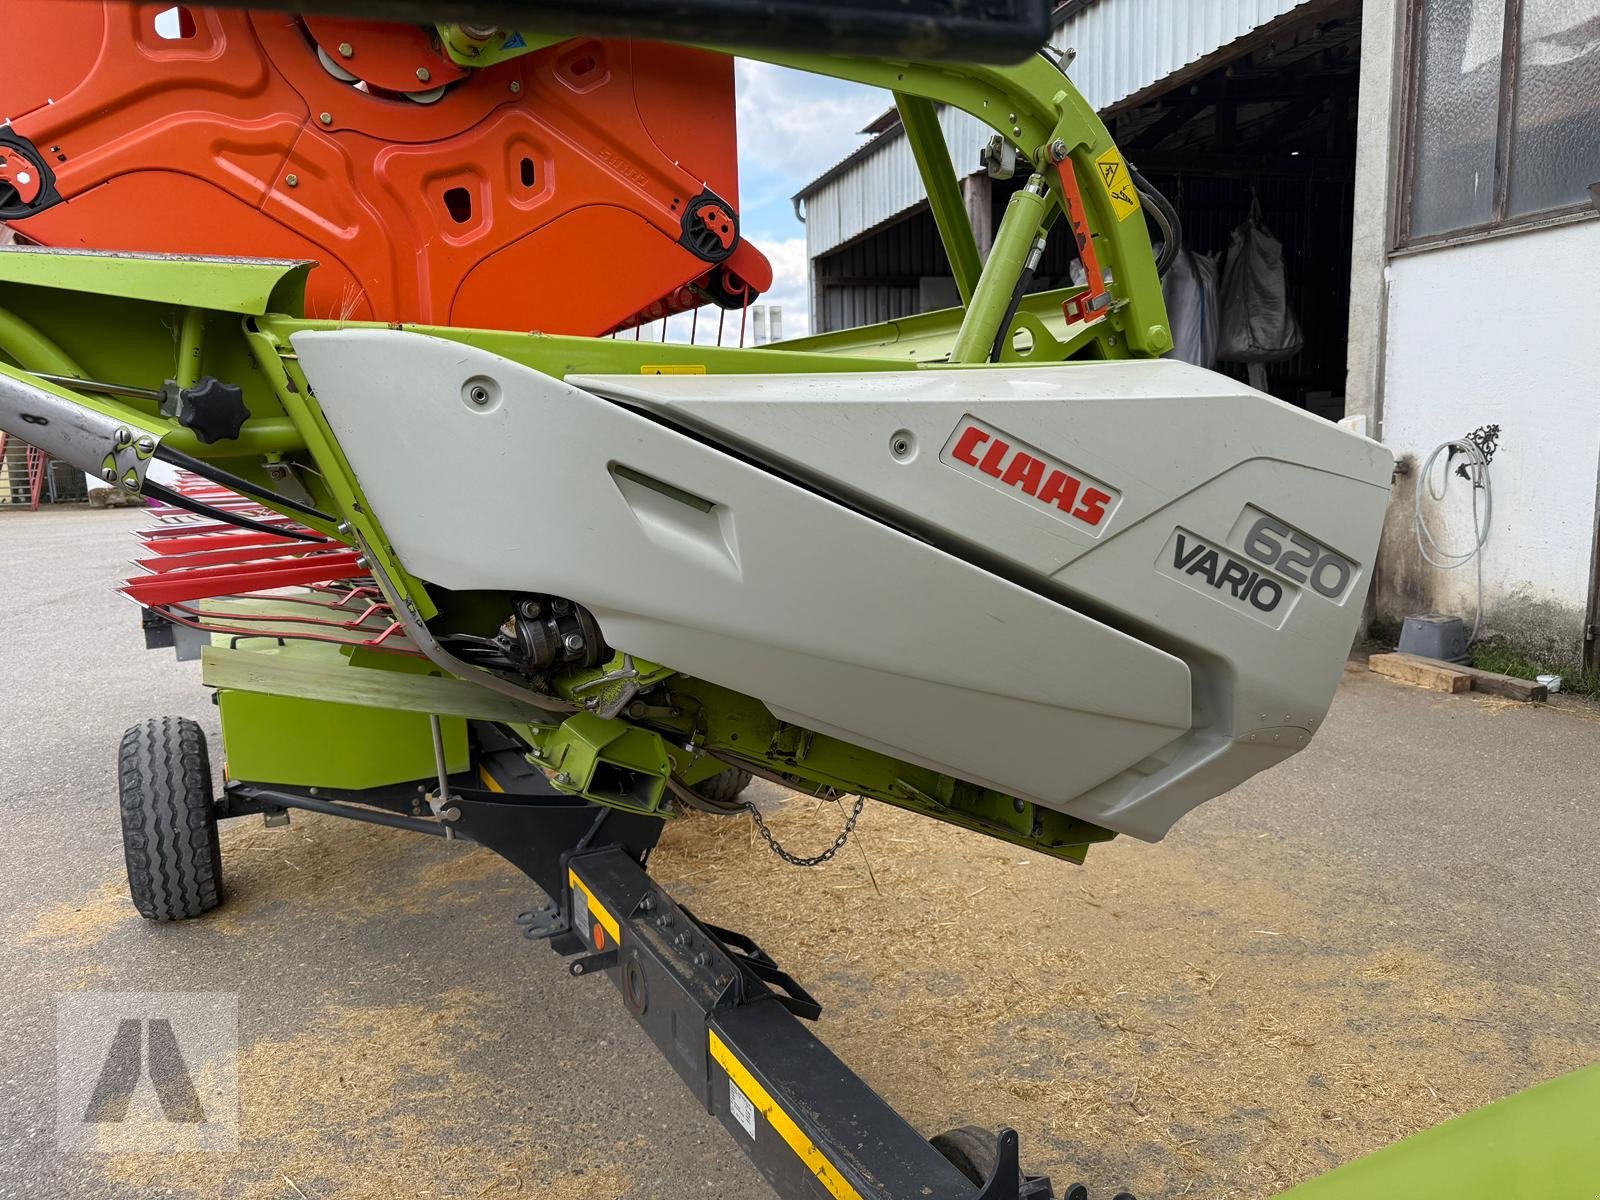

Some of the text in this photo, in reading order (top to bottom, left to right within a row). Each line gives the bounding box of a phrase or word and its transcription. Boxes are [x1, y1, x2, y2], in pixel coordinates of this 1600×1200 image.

[952, 427, 1111, 525] CLAAS
[1173, 534, 1282, 612] VARIO
[1244, 517, 1351, 598] 620
